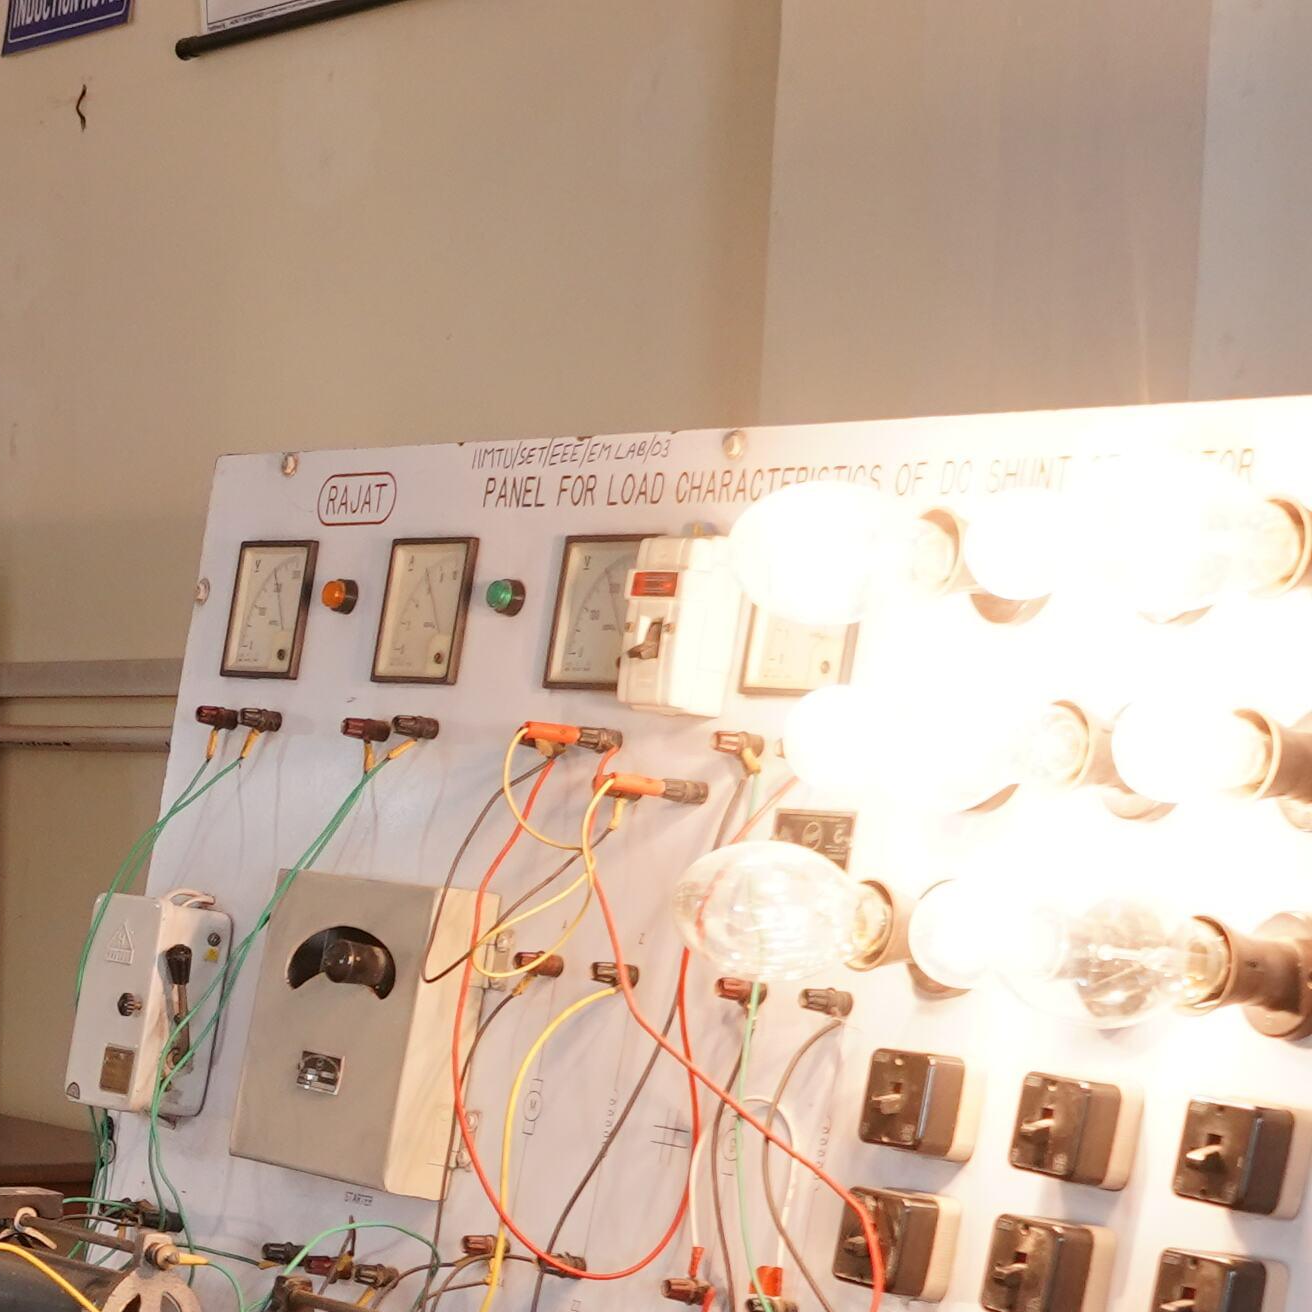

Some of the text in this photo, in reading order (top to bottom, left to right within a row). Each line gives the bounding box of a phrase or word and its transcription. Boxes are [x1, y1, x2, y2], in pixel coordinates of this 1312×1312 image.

[325, 483, 388, 515] RAJAT
[482, 476, 546, 508] PANEL
[556, 474, 598, 506] FOR
[607, 472, 665, 506] LOAD
[895, 462, 929, 496] OF
